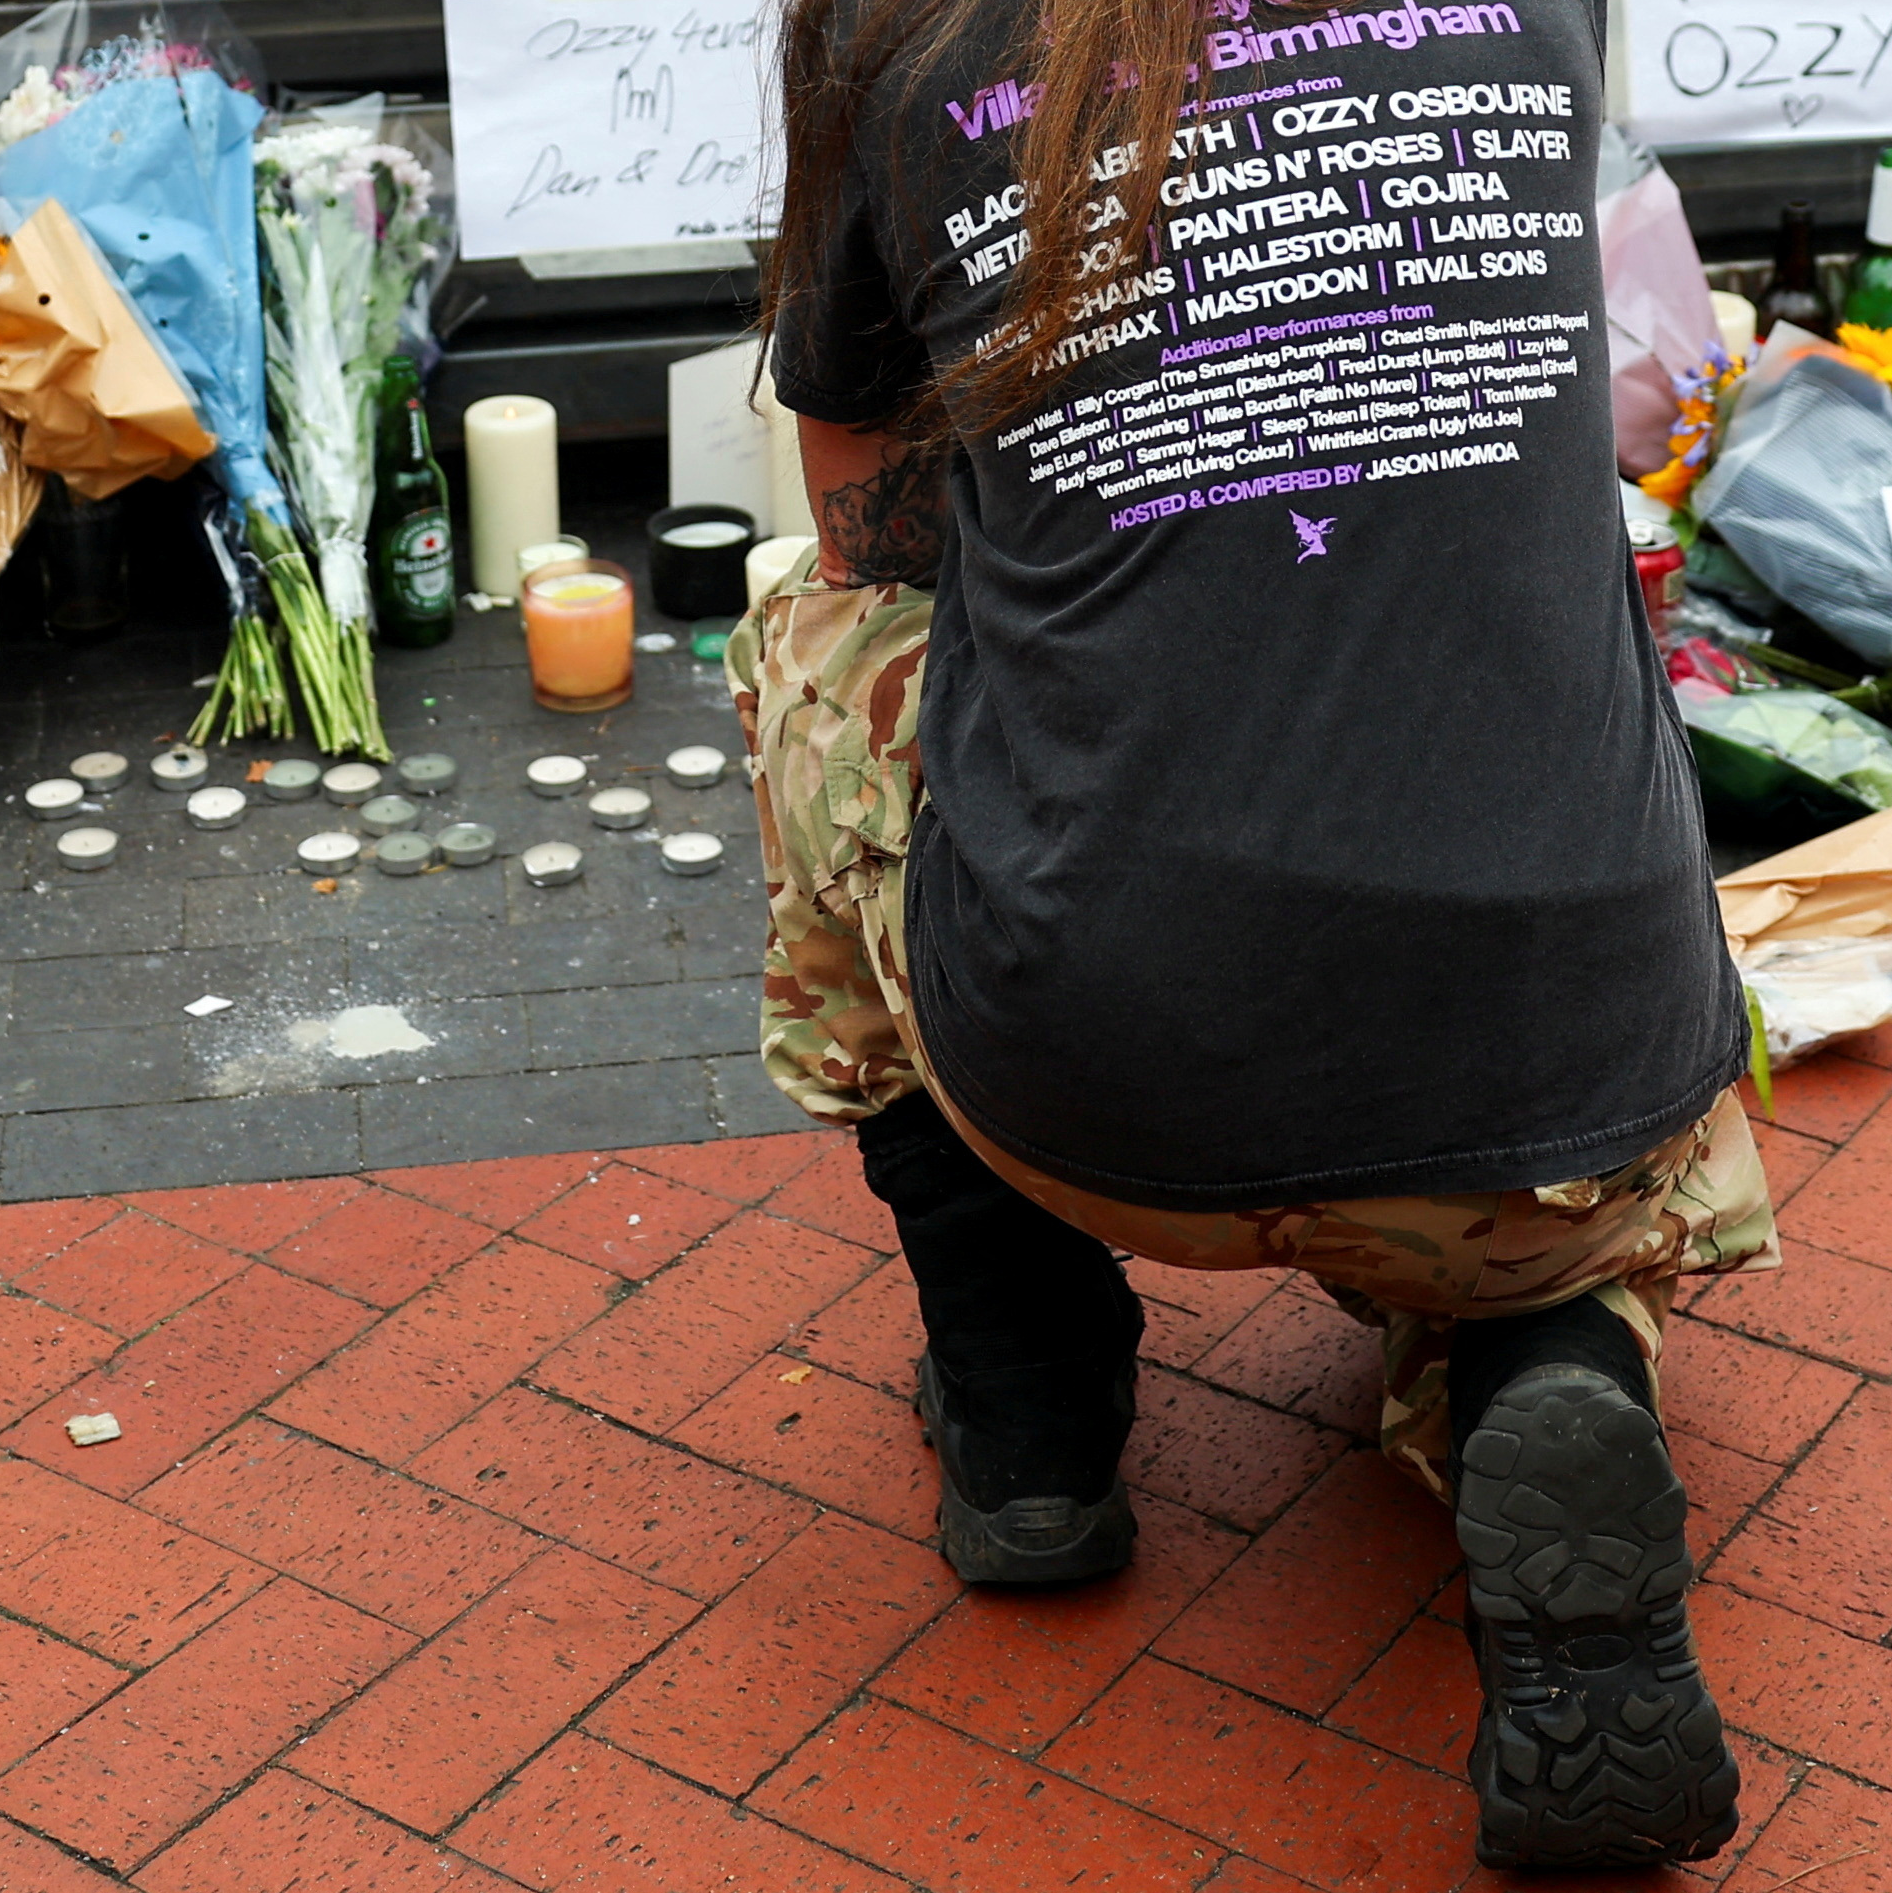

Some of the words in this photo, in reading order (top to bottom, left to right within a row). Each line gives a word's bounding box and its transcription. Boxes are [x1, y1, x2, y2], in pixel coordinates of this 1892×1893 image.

[524, 17, 658, 71] Ozzy
[1174, 81, 1296, 120] erformances
[1295, 74, 1344, 96] from
[1273, 93, 1380, 138] OZZY
[1389, 82, 1573, 119] OSBOURNE
[1160, 158, 1273, 208] GUNS
[1318, 131, 1444, 175] ROSES
[1472, 128, 1572, 163] SLAYER
[1169, 186, 1349, 252] PANTERA
[1381, 171, 1510, 210] GOJIRA
[1031, 309, 1163, 377] ANTHRAX
[1185, 264, 1369, 327] MASTODON
[1395, 257, 1477, 287] RIVAL
[1480, 249, 1548, 279] SONS
[1063, 266, 1176, 323] CHAINS
[1203, 220, 1404, 283] HALESTORM
[1430, 211, 1509, 246] LAMB
[1513, 211, 1544, 240] OF
[1545, 212, 1584, 240] GOD
[997, 421, 1035, 451] Andrew
[1033, 409, 1065, 433] Watt
[1073, 395, 1104, 417] Billy
[1104, 377, 1160, 407] Corgan
[1160, 368, 1198, 393] (The
[1198, 349, 1281, 381] Smashing
[1280, 332, 1367, 364] Pumpkins)
[1380, 326, 1424, 347] Chad
[1423, 323, 1469, 343] Smith
[1469, 319, 1503, 340] (Red
[1502, 316, 1526, 334] Hot
[1551, 310, 1590, 332] Peppers)
[1160, 326, 1253, 367] Additional
[1256, 308, 1389, 345] Performances
[1389, 304, 1435, 322] from
[1028, 461, 1056, 484] Jake
[1063, 449, 1088, 469] Lee
[1097, 434, 1120, 455] KK
[1120, 416, 1190, 448] Downing
[1202, 404, 1244, 426] Mike
[1245, 392, 1298, 417] Bordin
[1297, 383, 1345, 409] (Faith
[1344, 381, 1370, 401] No
[1370, 372, 1418, 396] More)
[1430, 368, 1470, 390] Papa
[1469, 367, 1483, 384] V
[1483, 361, 1543, 387] Perpetua
[1541, 355, 1578, 378] (Ghost)
[1029, 436, 1060, 459] Dave
[1060, 418, 1111, 449] Ellefson
[1122, 400, 1166, 424] David
[1166, 384, 1236, 412] Draiman
[1235, 361, 1325, 399] (Disturbed)
[1338, 358, 1378, 378] Fred
[1378, 352, 1422, 373] Durst
[1422, 347, 1465, 370] (Limp
[1465, 340, 1507, 363] Bizkit)
[1545, 335, 1570, 354] Hale
[1055, 472, 1087, 495] Rudy
[1086, 459, 1125, 483] Sarzo
[1136, 438, 1199, 466] Sammy
[1198, 426, 1247, 452] Hagar
[1261, 415, 1309, 438] Sleep
[1308, 408, 1359, 431] Token
[1369, 400, 1421, 425] (Sleep
[1419, 390, 1472, 415] Token)
[1482, 387, 1515, 405] Tom
[1514, 382, 1558, 402] Morello
[1096, 474, 1146, 500] Vernon
[1145, 465, 1184, 488] Reid
[1182, 453, 1236, 481] (Living
[1234, 438, 1295, 466] Colour)
[1306, 426, 1379, 453] Whitfield
[1379, 418, 1429, 441] Crane
[1428, 414, 1468, 438] (Ugly
[1467, 411, 1493, 431] Kid
[1493, 407, 1525, 428] Joe)
[1110, 493, 1187, 532] HOSTED
[1188, 488, 1208, 510] &
[1207, 464, 1334, 507] COMPERED
[1333, 462, 1364, 487] BY
[1365, 451, 1441, 482] JASON
[1440, 440, 1521, 470] MOMOA
